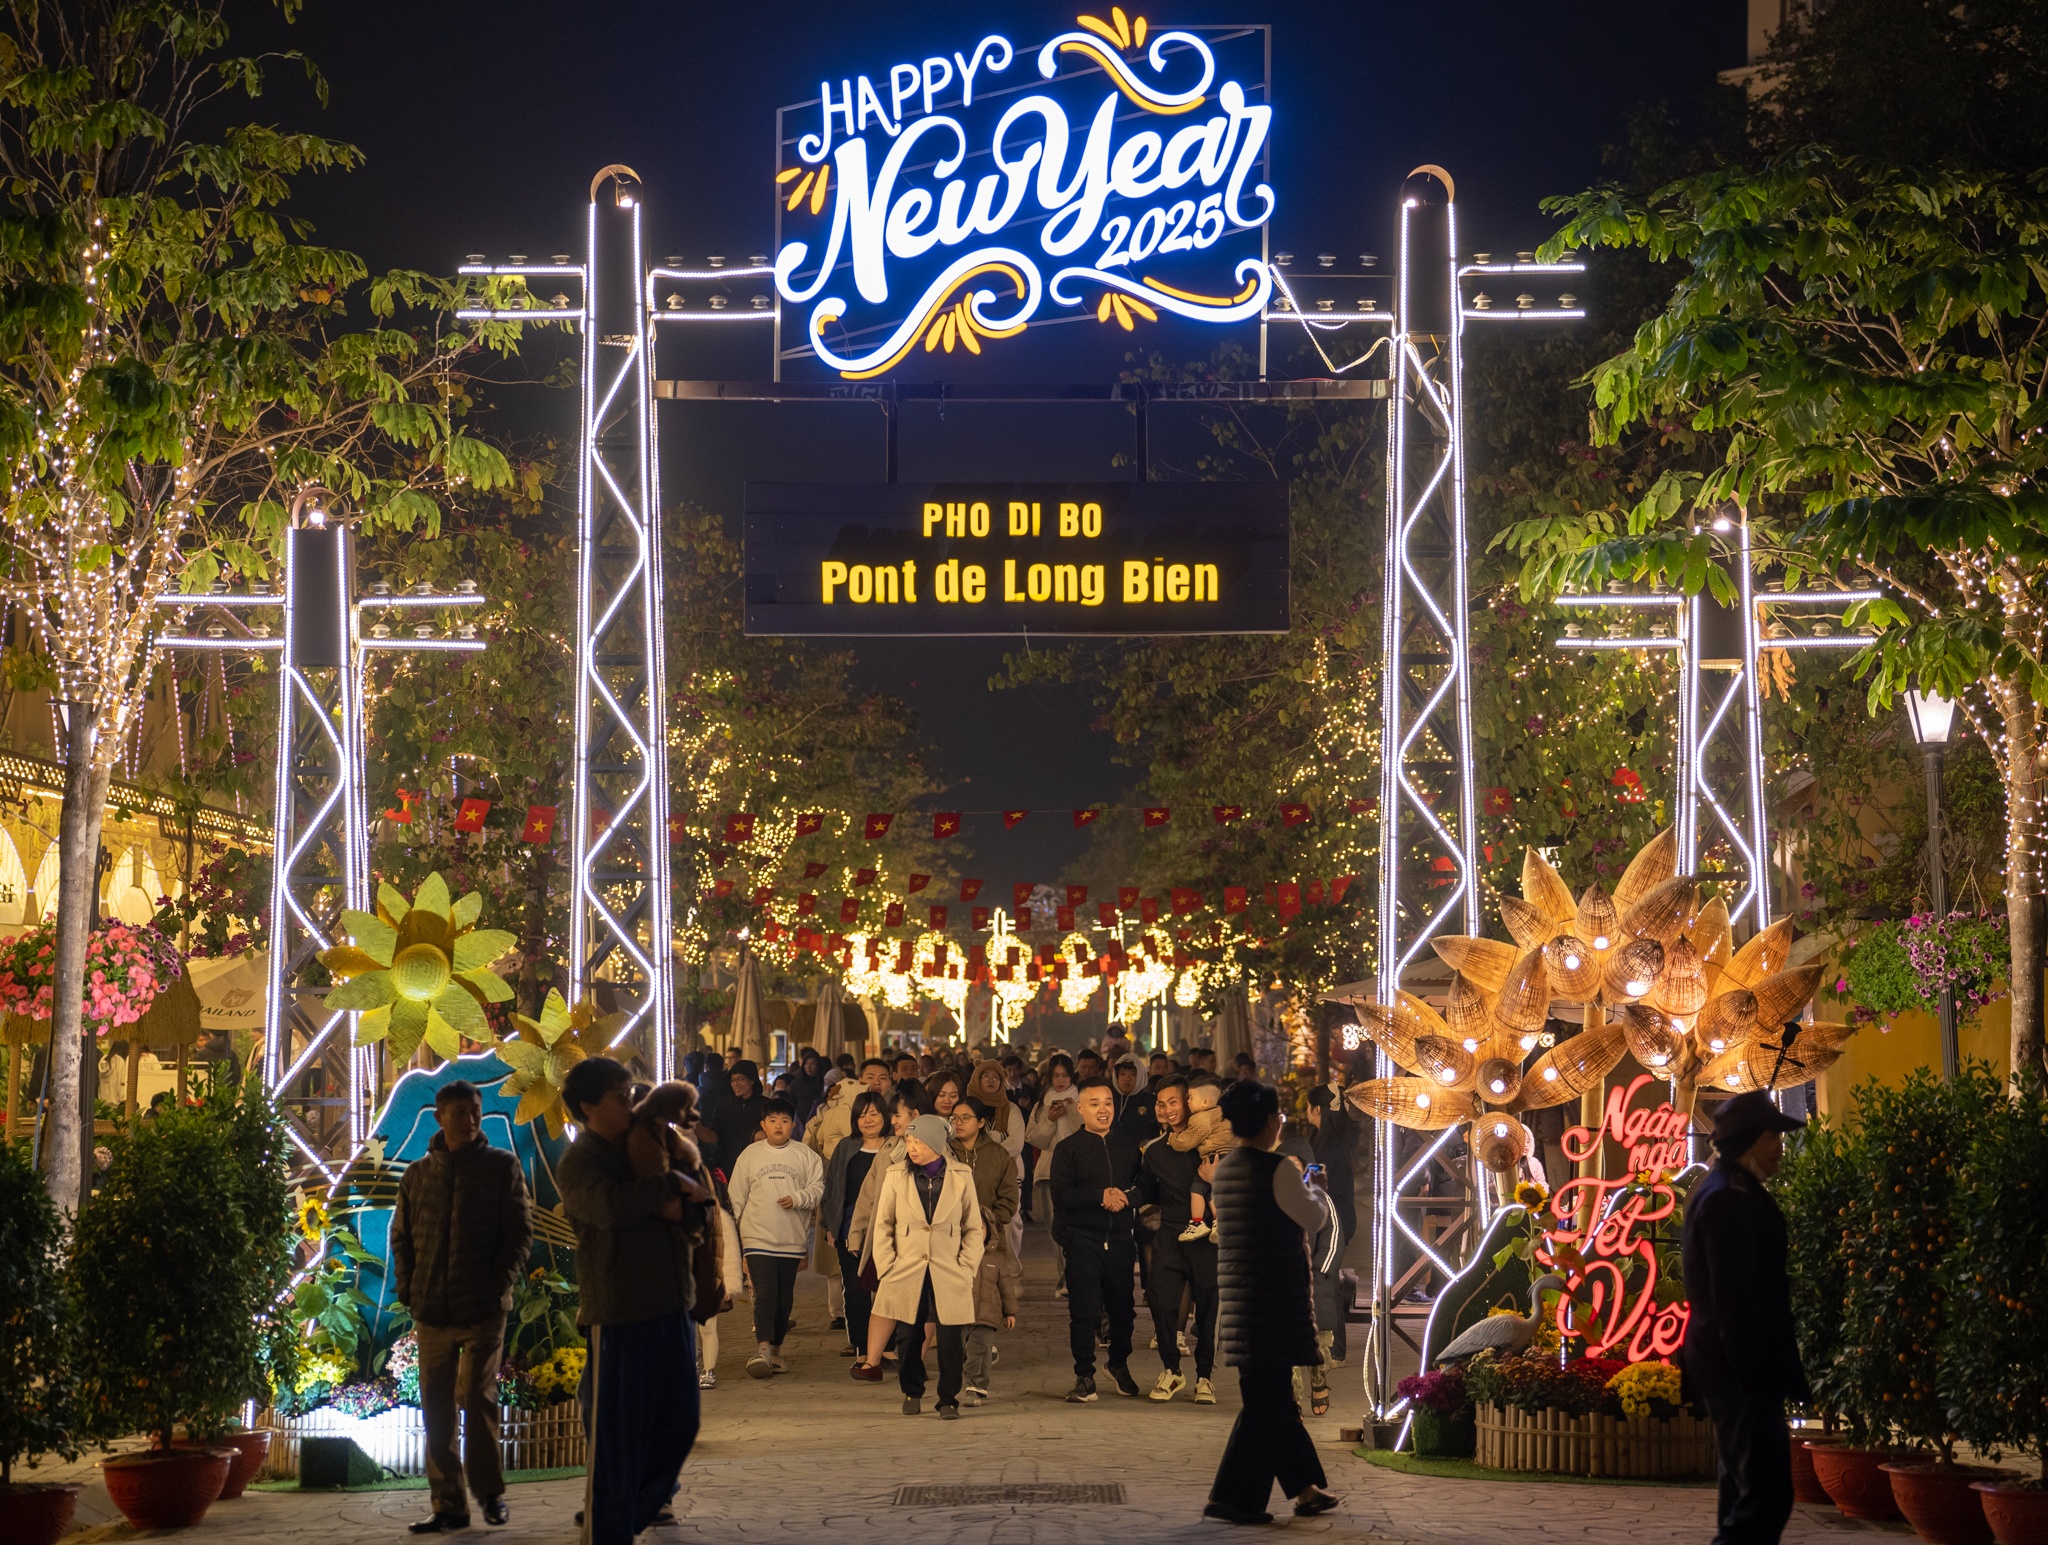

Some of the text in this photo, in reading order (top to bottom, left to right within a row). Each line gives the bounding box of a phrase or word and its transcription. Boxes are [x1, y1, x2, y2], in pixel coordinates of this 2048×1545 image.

[799, 35, 1013, 163] HAPPY
[775, 81, 1275, 303] New Year
[1095, 193, 1226, 270] 2025
[923, 502, 1102, 538] PHO DI BO
[821, 556, 1219, 607] Pont de Long Bien
[200, 1006, 257, 1017] AILAND
[1561, 1074, 1688, 1161] Ngân
[1627, 1139, 1688, 1184] nga
[1536, 1173, 1677, 1262] Tết
[1556, 1239, 1691, 1367] Việ
